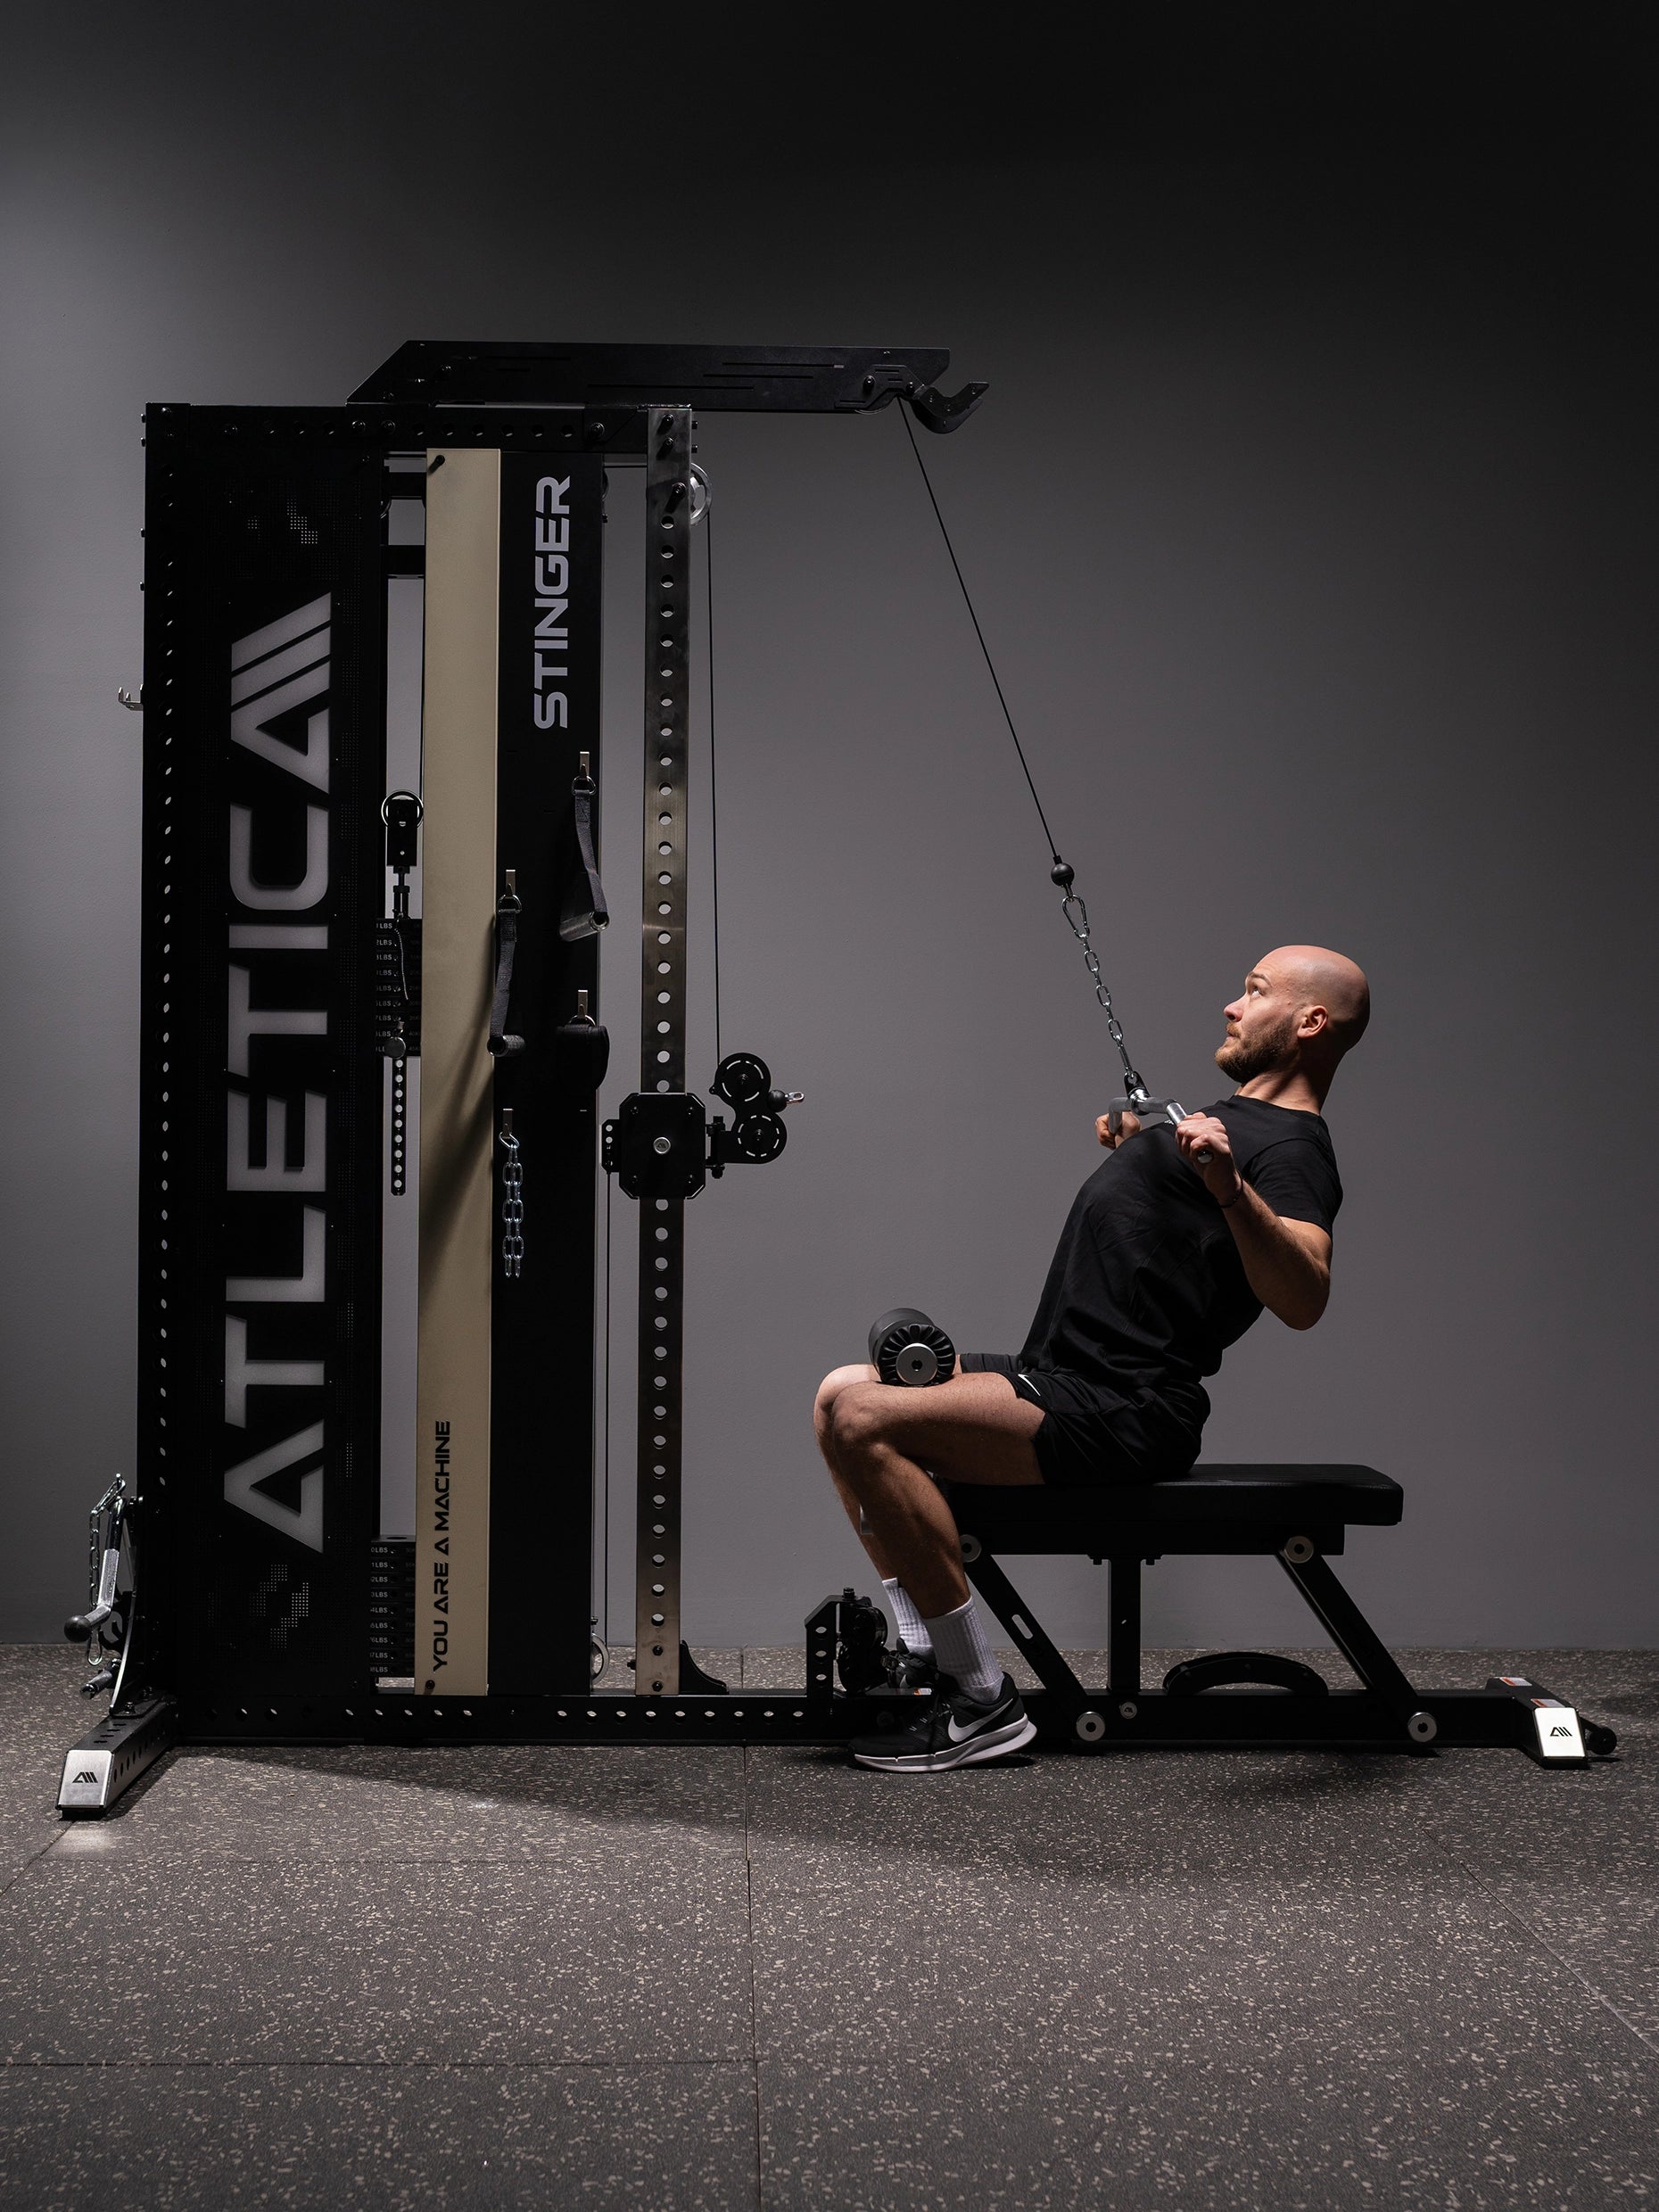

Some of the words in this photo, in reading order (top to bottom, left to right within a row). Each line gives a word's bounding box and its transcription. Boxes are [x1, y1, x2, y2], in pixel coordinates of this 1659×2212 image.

[533, 475, 571, 730] STINGER
[224, 591, 332, 1553] ATLETICA
[433, 1420, 450, 1531] MACHINE
[433, 1536, 450, 1556] A
[433, 1562, 450, 1615] ARE
[433, 1620, 449, 1672] YOU
